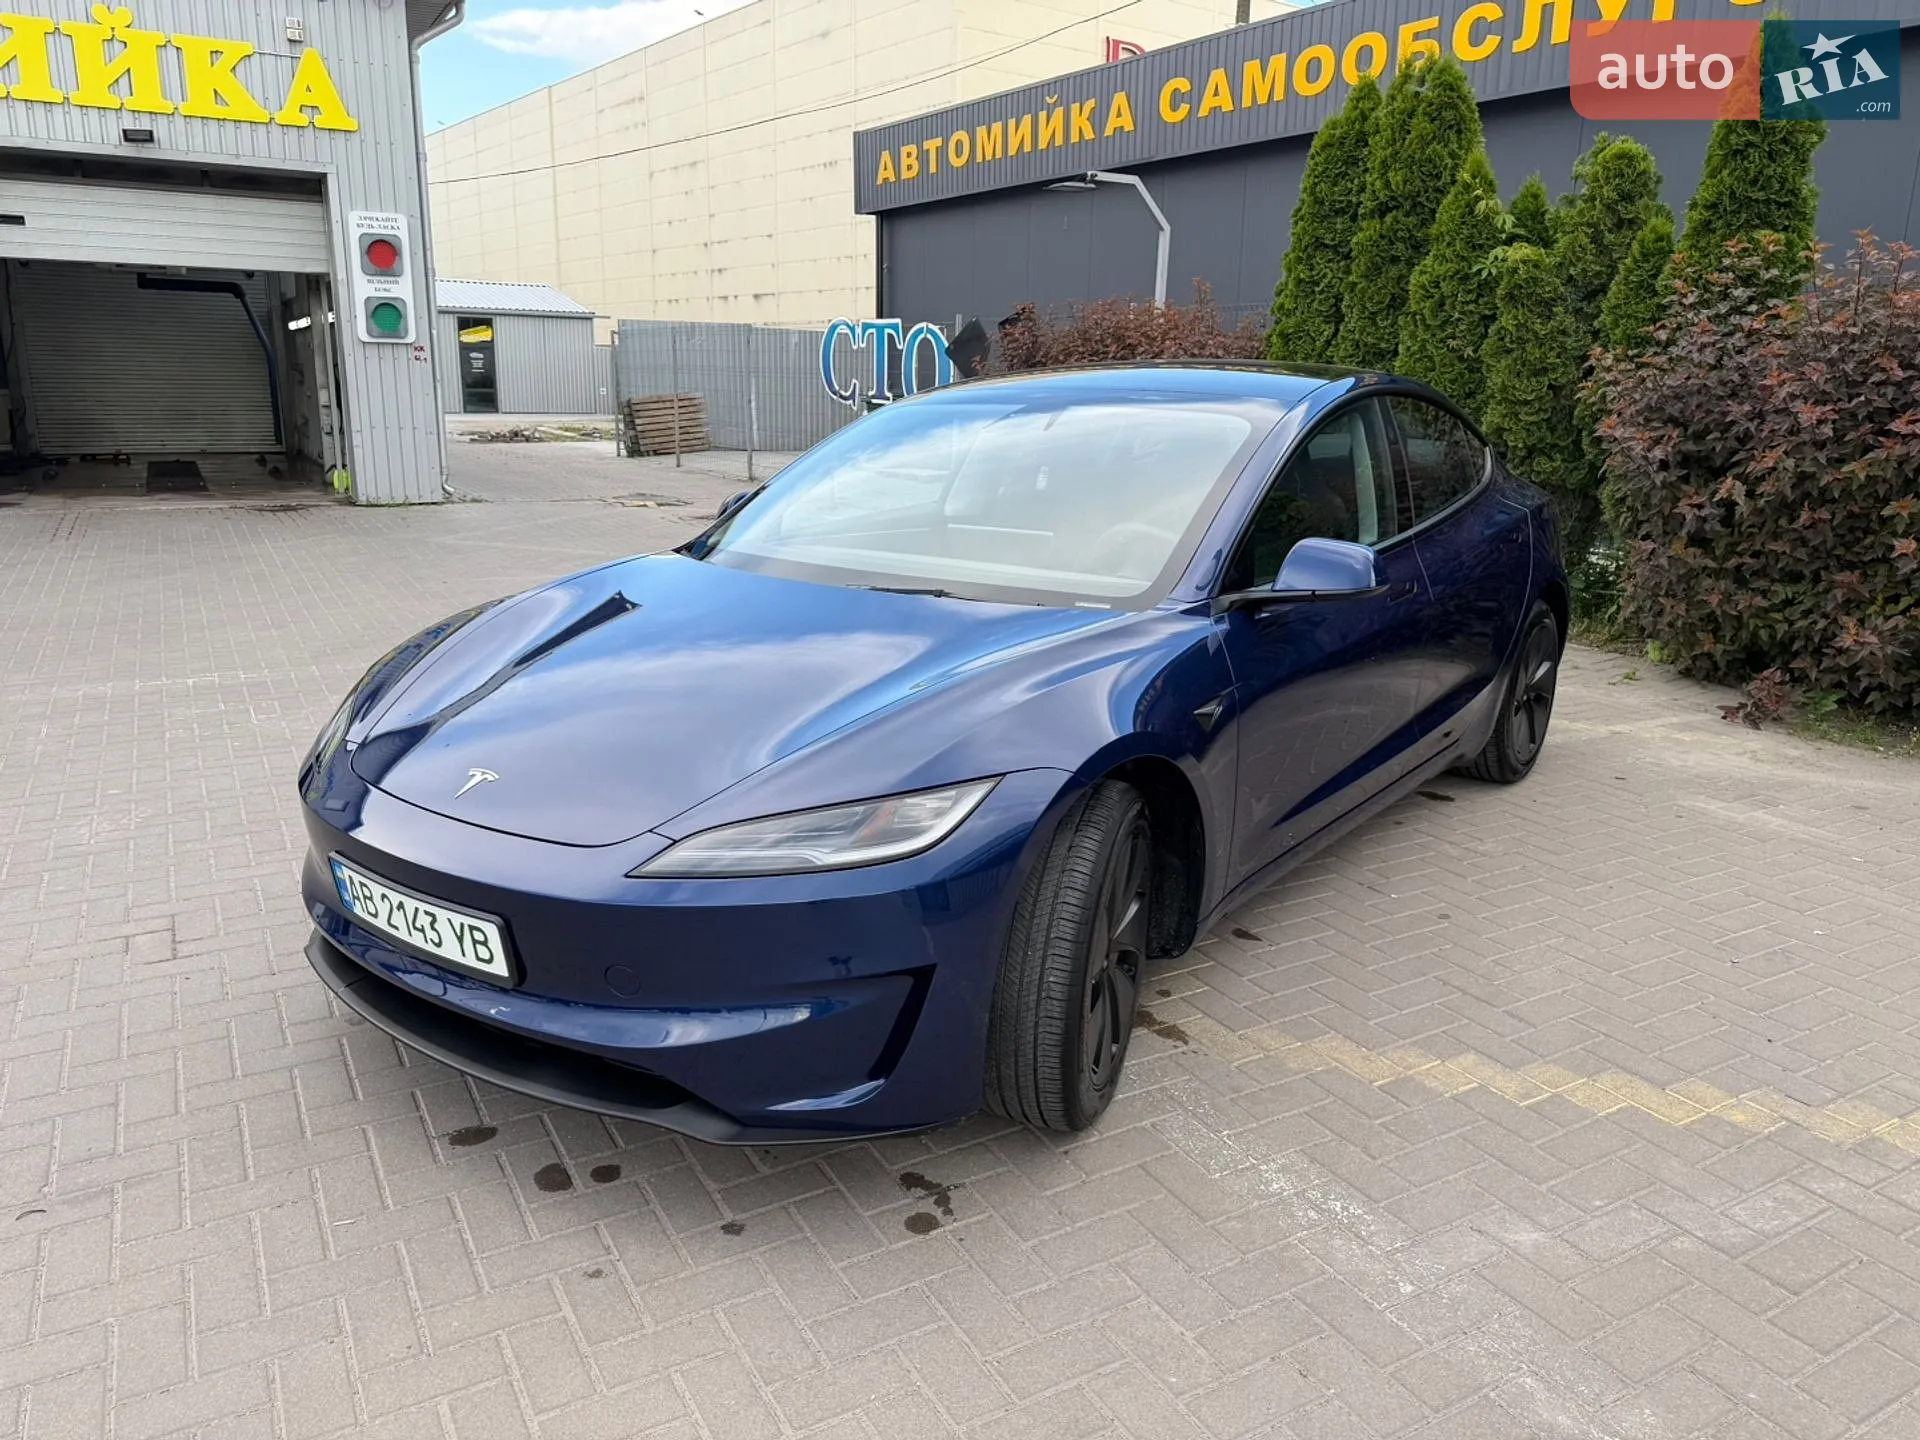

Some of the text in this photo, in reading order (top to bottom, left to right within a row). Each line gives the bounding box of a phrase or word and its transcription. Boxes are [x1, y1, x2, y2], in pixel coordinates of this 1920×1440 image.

[876, 91, 1135, 185] АВТОМИЙКА
[820, 316, 953, 410] СТО
[348, 874, 494, 965] AB 2143 YB
